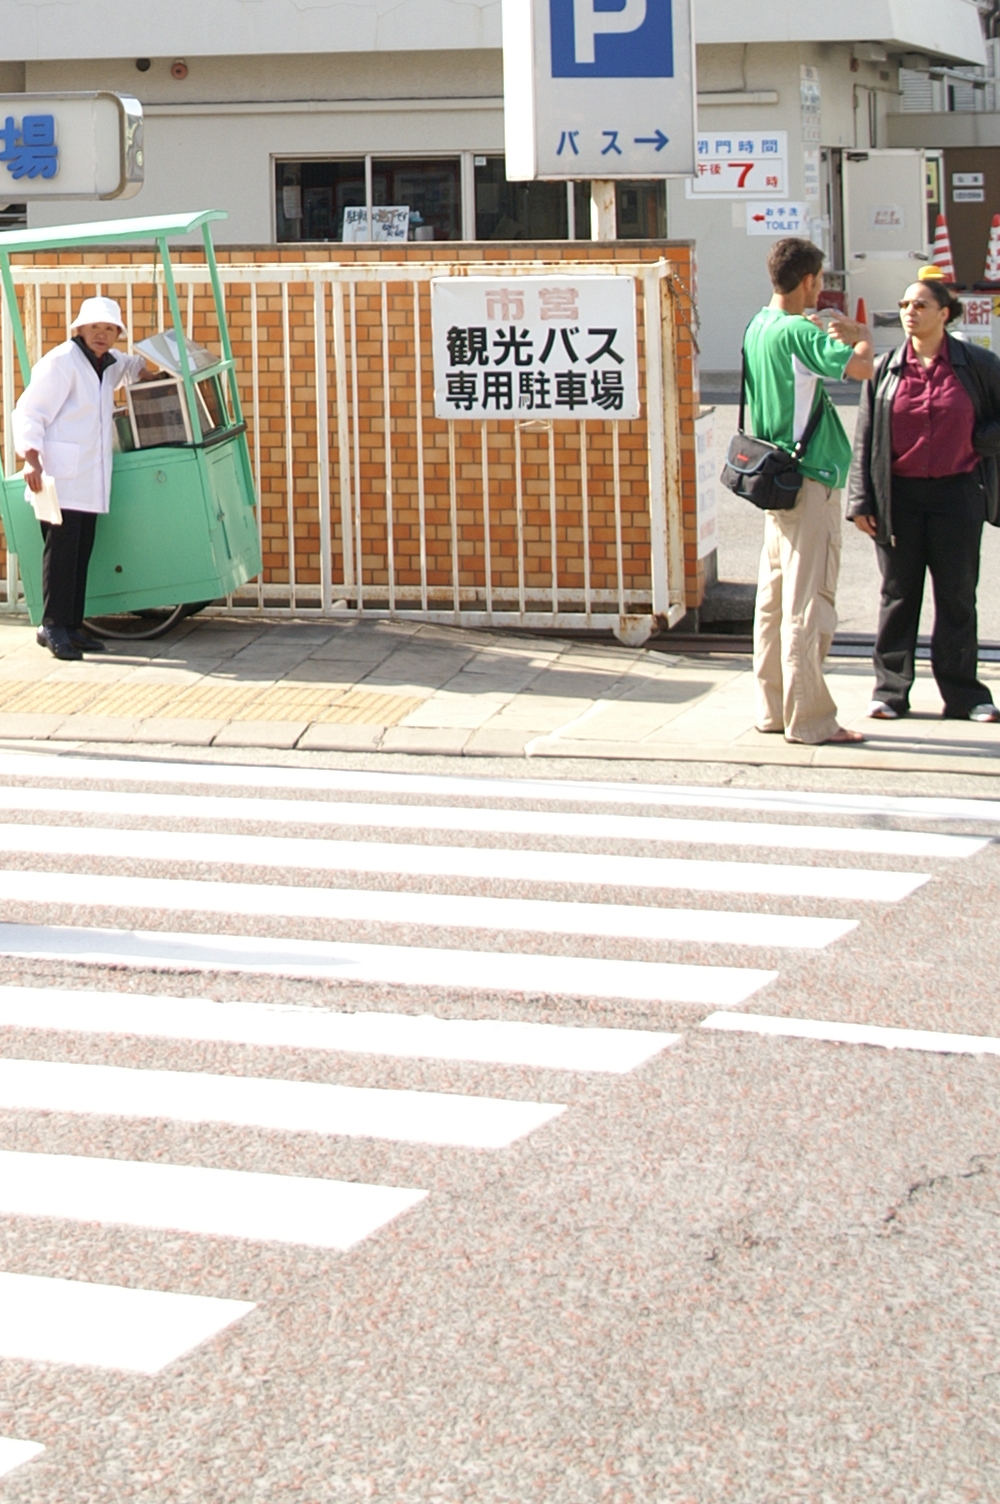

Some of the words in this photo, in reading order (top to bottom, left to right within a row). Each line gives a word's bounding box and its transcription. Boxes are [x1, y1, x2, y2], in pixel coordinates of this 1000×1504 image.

[556, 130, 622, 156] バス
[727, 162, 755, 188] 7
[765, 220, 800, 231] TOILET
[485, 287, 579, 321] 市営
[446, 325, 625, 367] 観光バス
[445, 369, 625, 411] 専用駐車場
